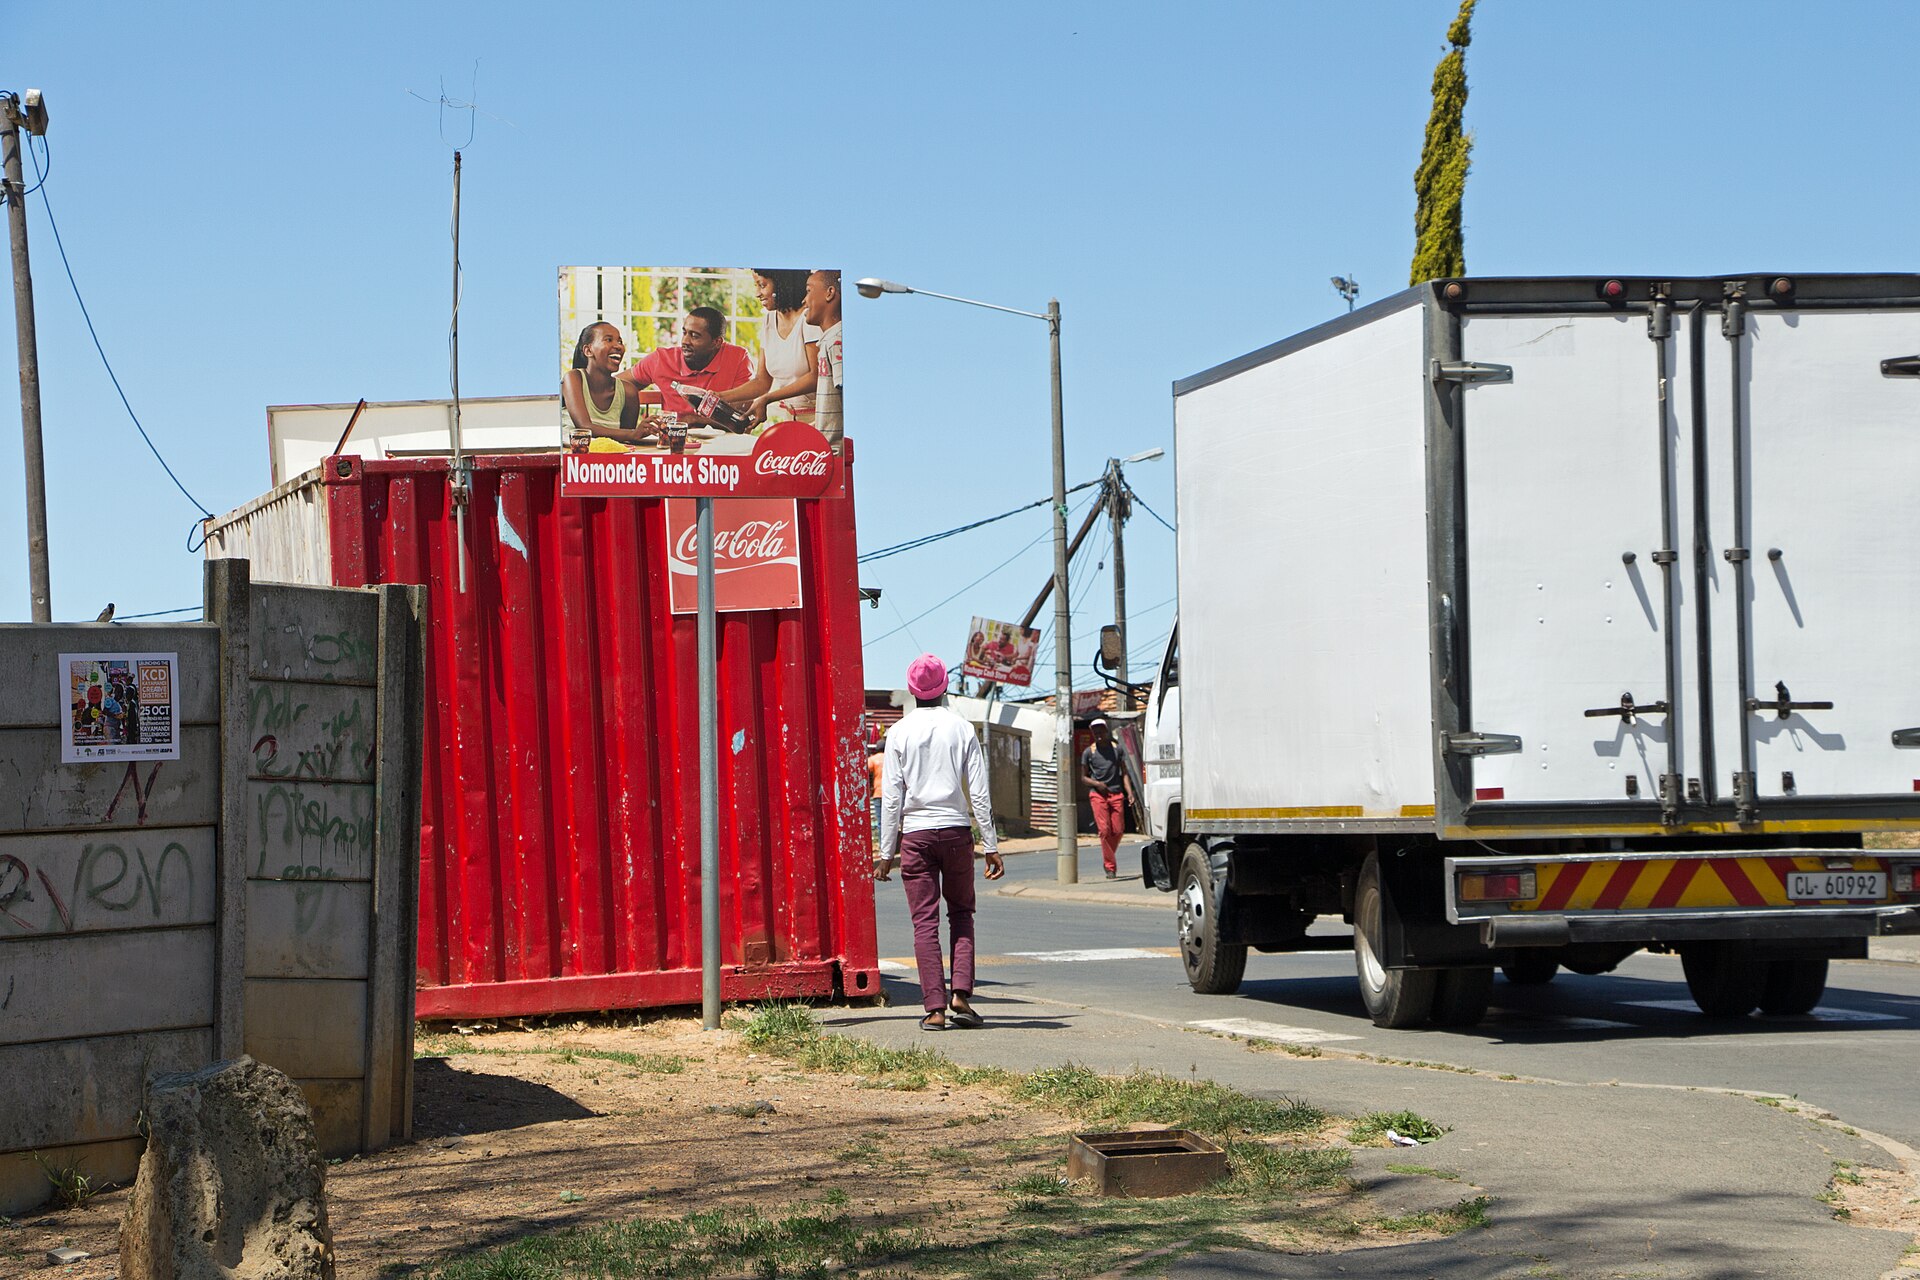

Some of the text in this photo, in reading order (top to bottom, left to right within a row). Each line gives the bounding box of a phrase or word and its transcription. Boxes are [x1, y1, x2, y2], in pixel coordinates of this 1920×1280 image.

[567, 456, 740, 490] Nomonde Tuck Shop
[754, 450, 831, 477] Coca-Cola
[676, 520, 790, 561] Ca-Cola
[141, 669, 167, 681] KCD
[140, 705, 170, 716] 25 OCT
[1825, 875, 1877, 895] 60992
